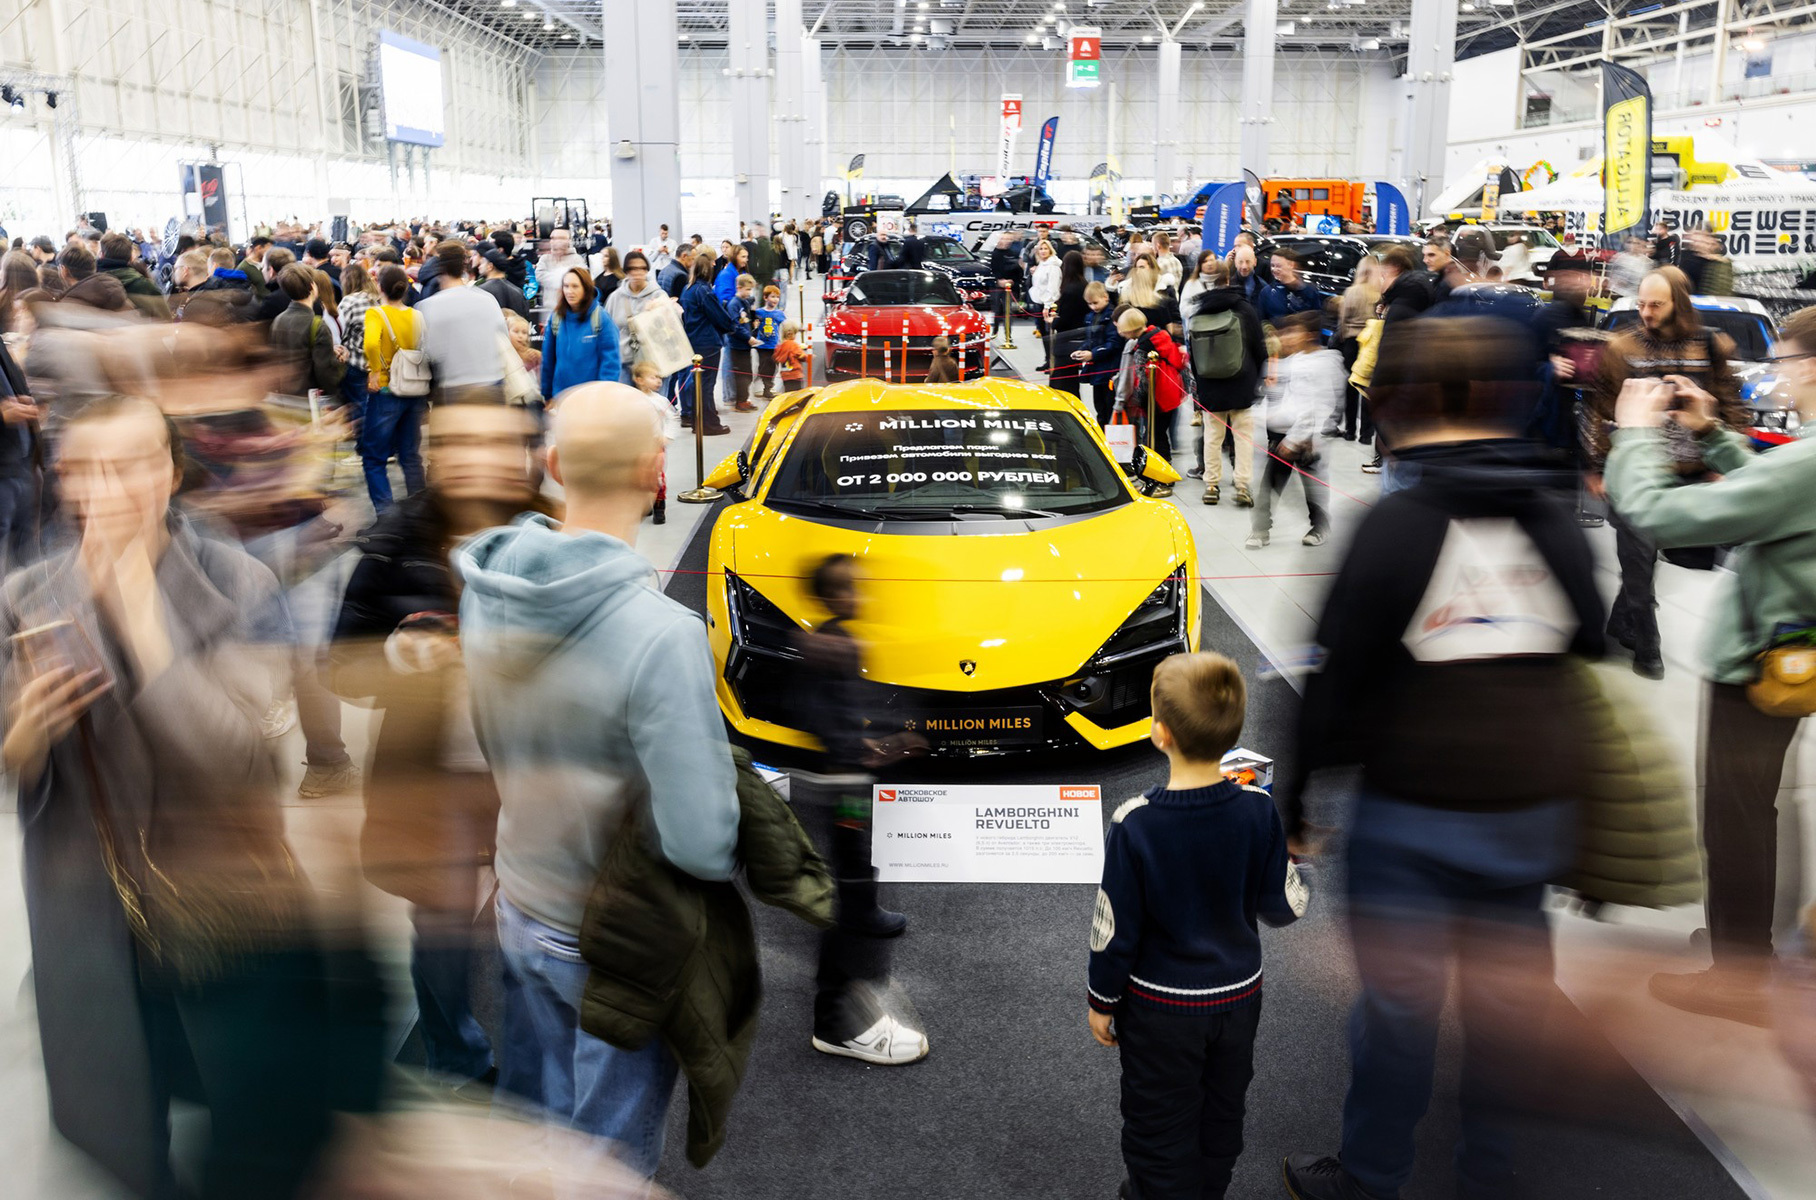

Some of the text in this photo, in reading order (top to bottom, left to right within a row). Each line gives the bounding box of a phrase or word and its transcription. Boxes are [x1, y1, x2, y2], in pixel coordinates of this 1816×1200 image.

[879, 419, 1054, 432] MILLION MILES
[893, 444, 964, 452] Предлагаем
[900, 450, 972, 458] автомобили
[974, 451, 1029, 459] выгоднее
[837, 471, 1060, 486] ОТ 2 000 000 РУБЛЕЙ
[926, 717, 1032, 730] MILLION MILES
[1062, 790, 1096, 798] НОВОЕ
[975, 807, 1080, 818] LAMBORGHINI
[975, 819, 1050, 830] REVUELTO
